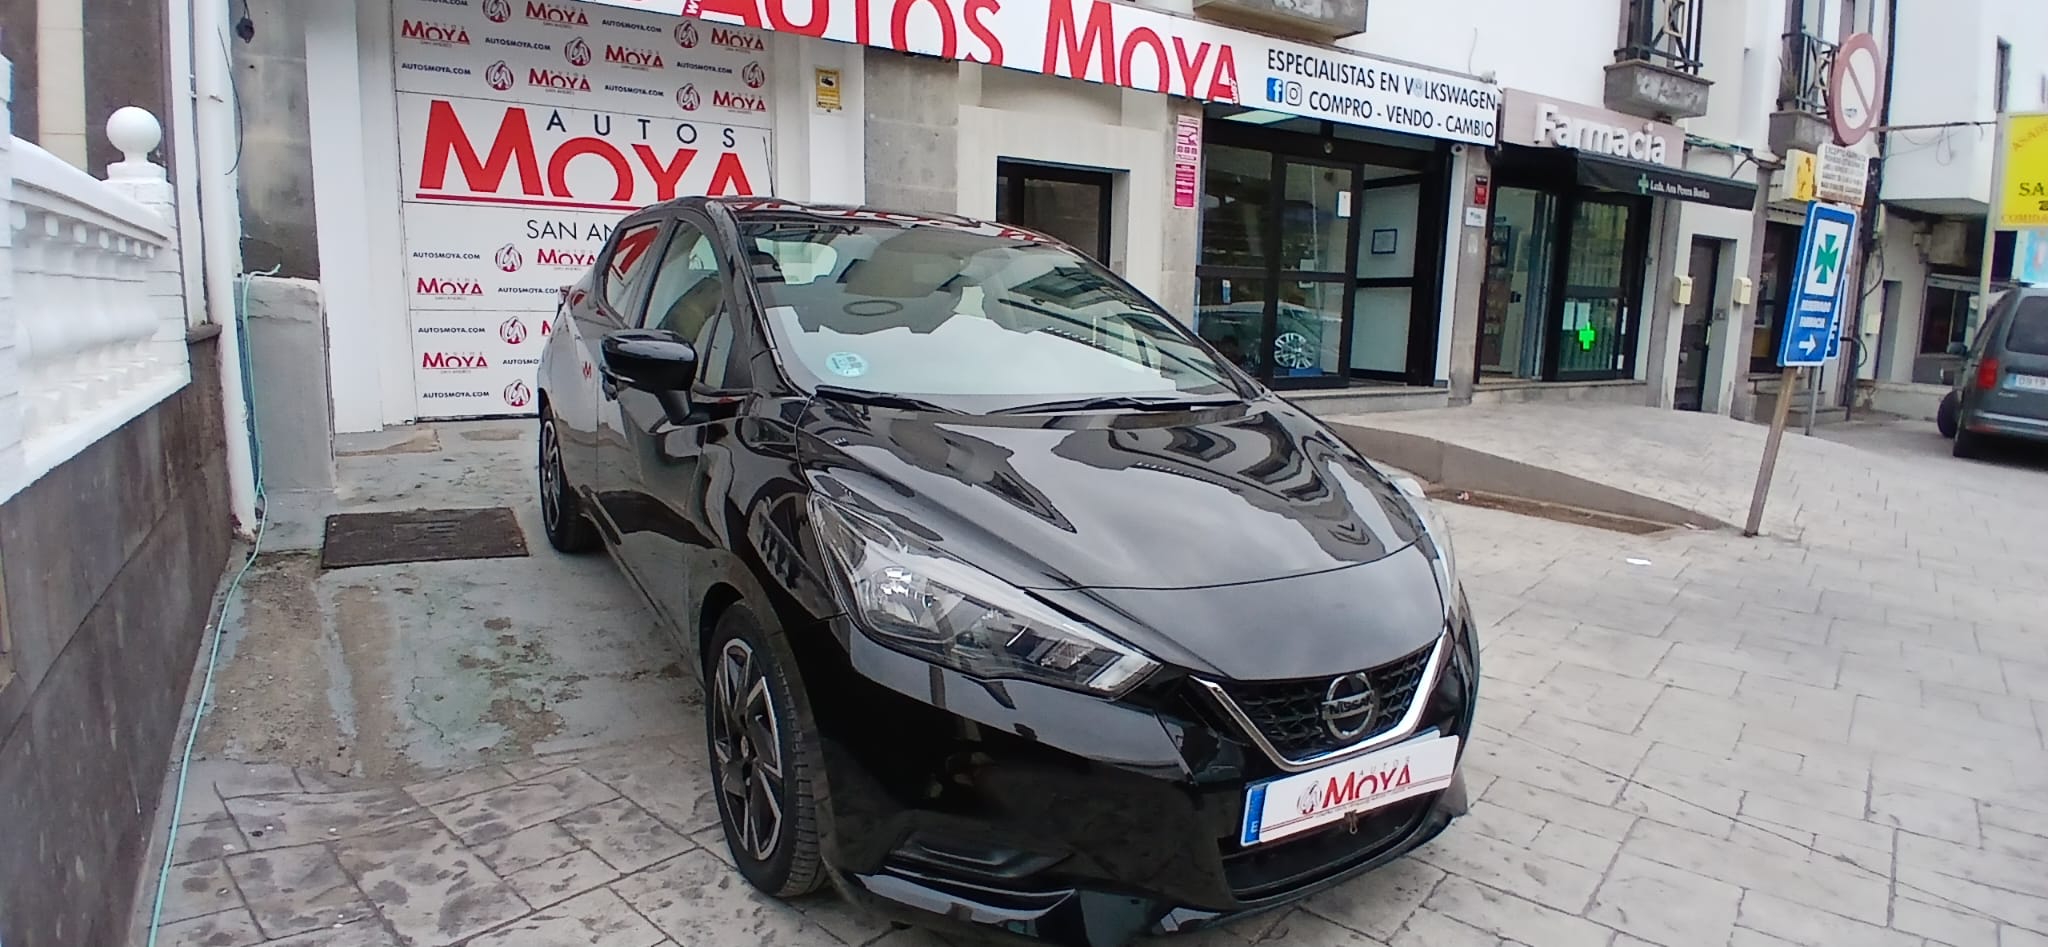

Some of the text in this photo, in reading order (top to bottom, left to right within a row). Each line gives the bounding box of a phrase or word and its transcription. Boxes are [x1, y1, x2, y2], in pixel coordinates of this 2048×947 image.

[525, 1, 589, 25] MOYA
[401, 19, 470, 44] MOYA
[602, 18, 662, 33] AUTOSMOYA.COM
[485, 37, 551, 51] AUTOSMOYA.COM
[711, 28, 765, 51] MOYA
[605, 44, 664, 68] MOYA
[1043, 0, 1240, 105] MOYA
[401, 62, 471, 75] AUTOSMOYA.COM
[676, 61, 733, 74] AUTOSMOYA.COM
[1267, 48, 1375, 90] ESPECIALISTAS
[1380, 71, 1399, 94] EN
[528, 68, 591, 92] MOYA
[604, 84, 664, 97] AUTOSMOYA.COM
[712, 90, 766, 112] MOYA
[1309, 90, 1373, 119] COMPRO
[1386, 104, 1434, 129] VENDO
[1445, 115, 1494, 139] CAMBIO
[546, 109, 736, 148] AUTOS
[1534, 102, 1667, 165] Farmacia
[419, 99, 754, 201] MOYA
[526, 219, 577, 241] SAN
[412, 251, 480, 260] AUTOSMOYA.COM
[416, 277, 483, 295] MOYA
[422, 352, 488, 368] MOYA
[1329, 695, 1374, 715] NISSAN
[1322, 763, 1411, 809] MOYA
[1250, 820, 1259, 834] E
